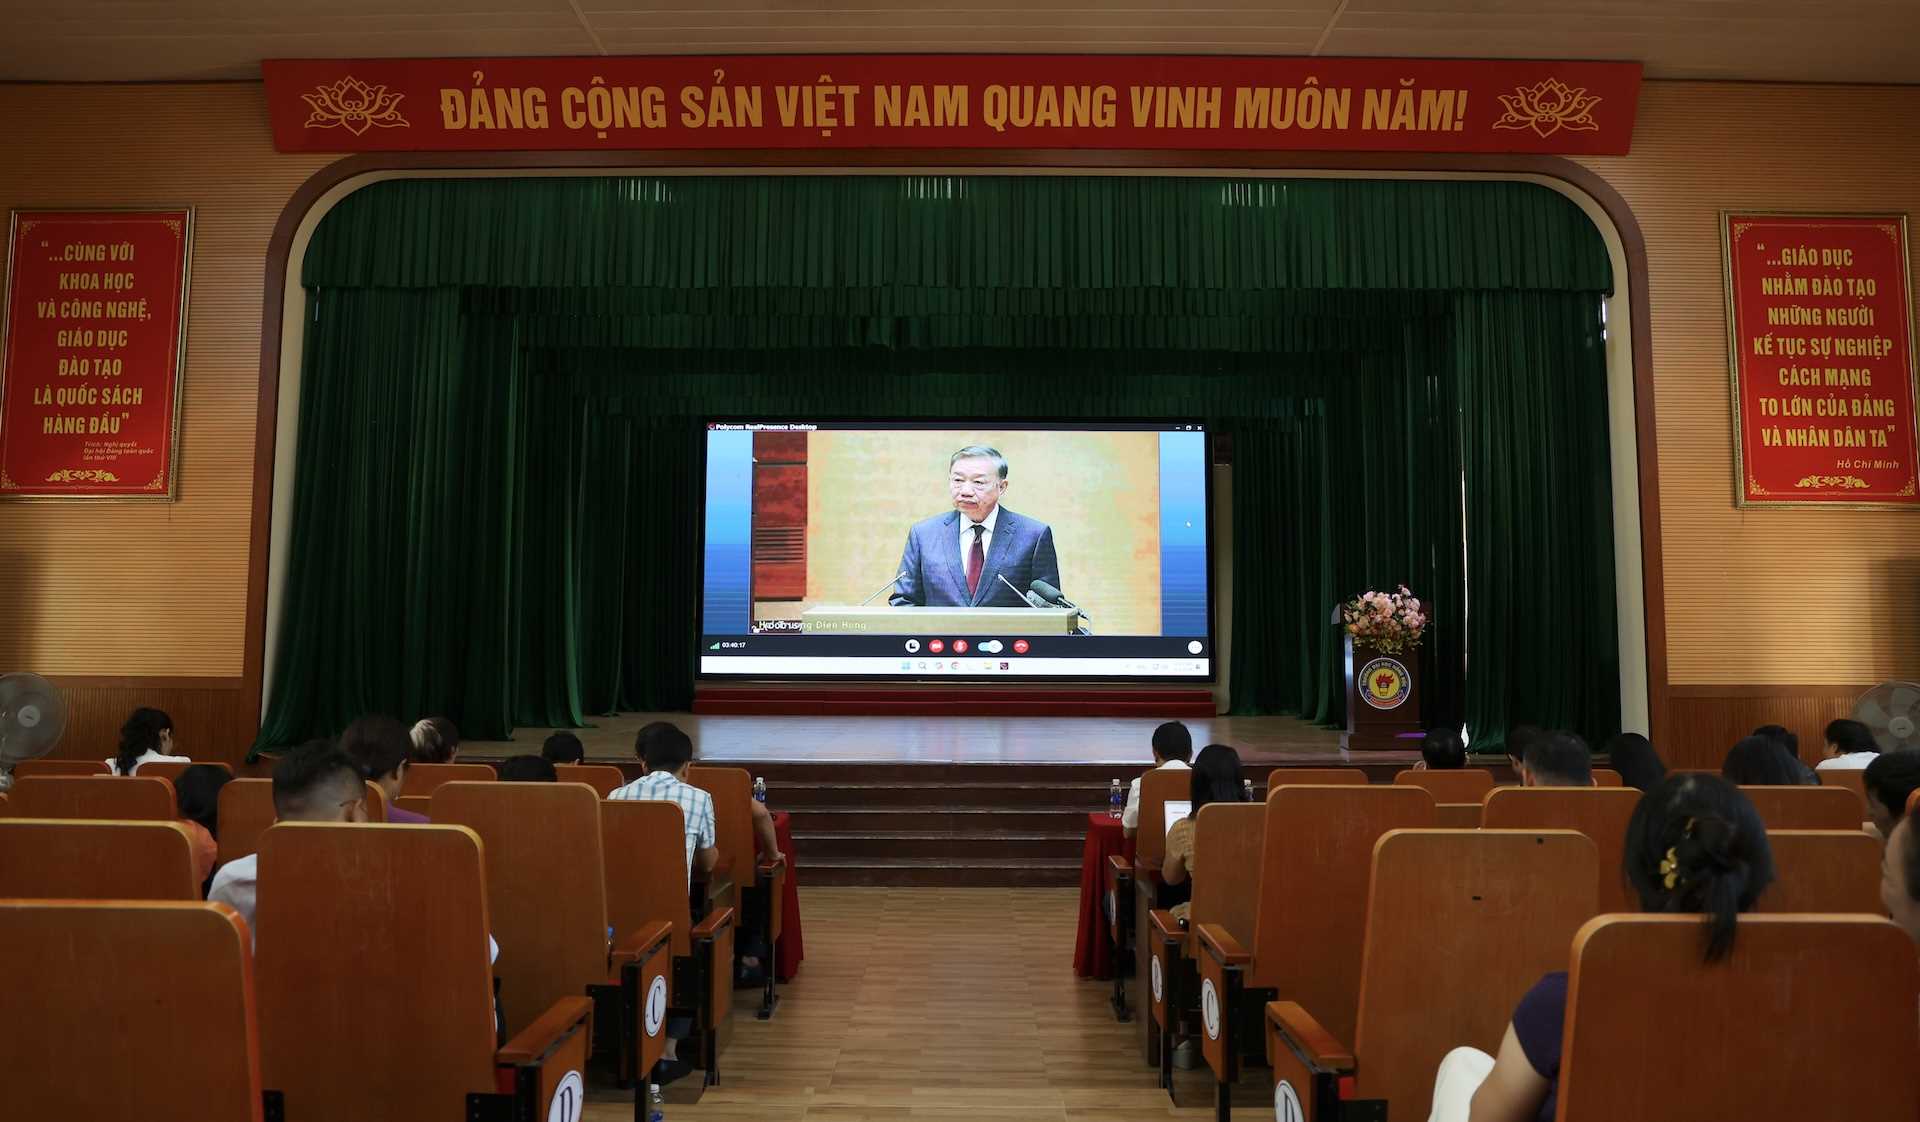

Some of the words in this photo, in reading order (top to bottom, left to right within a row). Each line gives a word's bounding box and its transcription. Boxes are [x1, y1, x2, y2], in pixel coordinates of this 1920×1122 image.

[440, 71, 548, 129] ĐẢNG
[561, 77, 666, 138] CỘNG
[681, 69, 762, 128] SẢN
[776, 75, 859, 136] VIỆT
[875, 85, 968, 126] NAM
[984, 85, 1116, 131] QUANG
[1131, 86, 1221, 128] VINH
[1234, 77, 1348, 129] MUÔN
[1362, 79, 1467, 131] NĂM!
[111, 241, 134, 260] VỚI
[1822, 249, 1852, 269] DỤC
[60, 273, 99, 289] KHOA
[104, 273, 134, 292] HỌC
[1762, 272, 1808, 295] NHẰM
[1812, 275, 1842, 296] ĐÀO
[1847, 279, 1876, 299] TẠO
[38, 298, 56, 318] VÀ
[61, 298, 102, 318] CÔNG
[1768, 305, 1821, 325] NHỮNG
[1826, 304, 1873, 326] NGƯỜI
[58, 327, 93, 347] GIÁO
[97, 330, 127, 350] DỤC
[1754, 333, 1773, 355] KẾ
[1777, 338, 1806, 359] TỤC
[1811, 337, 1831, 359] SỰ
[1835, 335, 1892, 360] NGHIỆP
[59, 356, 89, 375] ĐÀO
[94, 359, 121, 379] TẠO
[1779, 365, 1820, 385] CÁCH
[1825, 369, 1871, 389] MẠNG
[34, 384, 52, 404] LÀ
[57, 383, 97, 406] QUỐC
[102, 385, 142, 404] SÁCH
[1760, 398, 1778, 416] TO
[1782, 395, 1812, 416] LỚN
[1817, 393, 1848, 416] CỦA
[1852, 393, 1894, 416] ĐẢNG
[44, 414, 85, 433] HÀNG
[1762, 425, 1782, 446] VÀ
[1786, 426, 1829, 446] NHÂN
[1833, 426, 1865, 447] DÂN
[1874, 460, 1898, 468] Minh
[652, 986, 660, 1024] C
